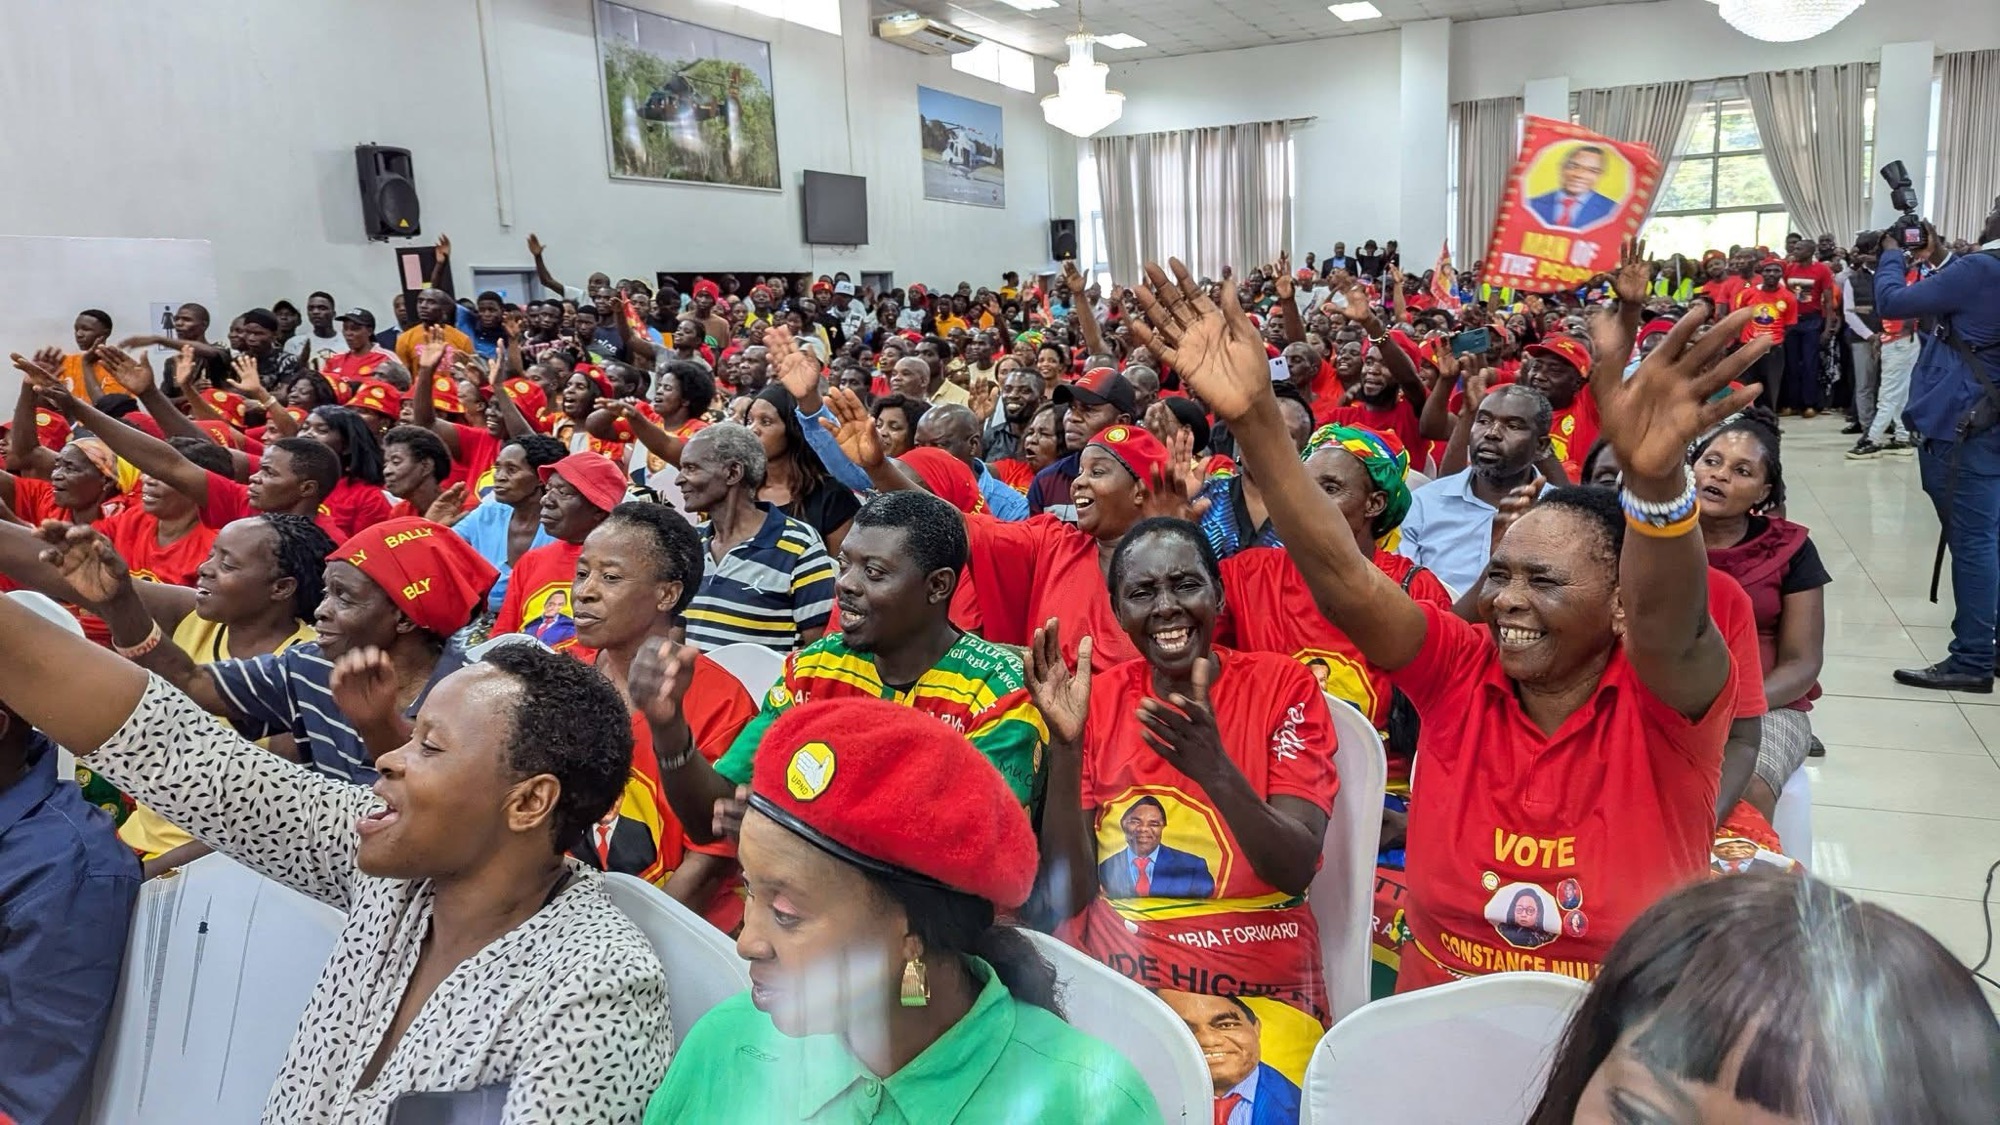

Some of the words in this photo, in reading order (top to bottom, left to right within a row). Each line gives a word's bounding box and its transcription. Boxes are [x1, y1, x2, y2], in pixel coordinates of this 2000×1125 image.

[1500, 252, 1538, 278] THE
[1570, 239, 1600, 268] OF
[384, 527, 434, 549] BALLY
[402, 577, 431, 601] BLY
[790, 774, 809, 796] UPND
[1494, 827, 1577, 869] VOTE
[1222, 922, 1299, 945] FORWARD
[1440, 932, 1546, 972] CONSTANCE
